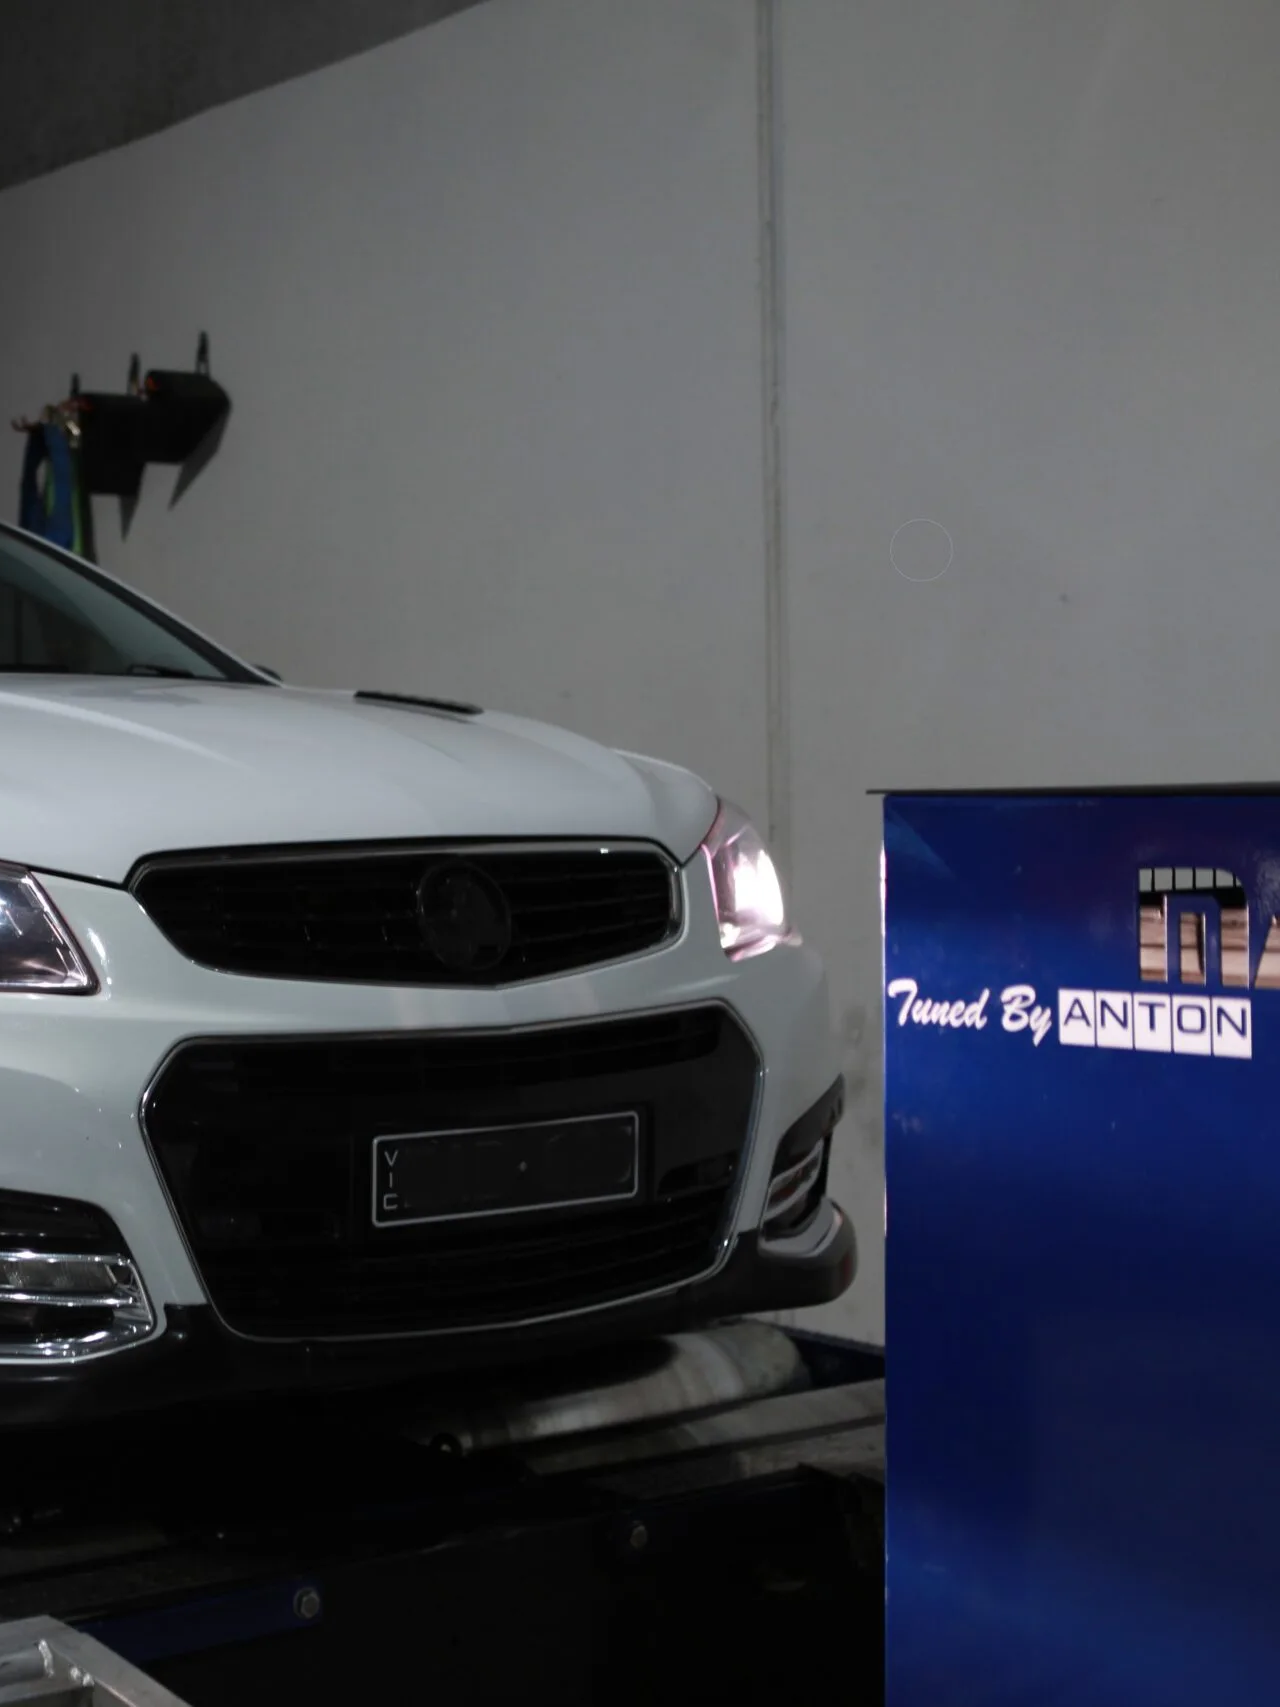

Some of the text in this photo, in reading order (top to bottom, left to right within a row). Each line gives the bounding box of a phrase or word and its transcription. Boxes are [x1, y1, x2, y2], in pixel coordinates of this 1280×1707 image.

[888, 978, 1249, 1047] Tuned By ANTON
